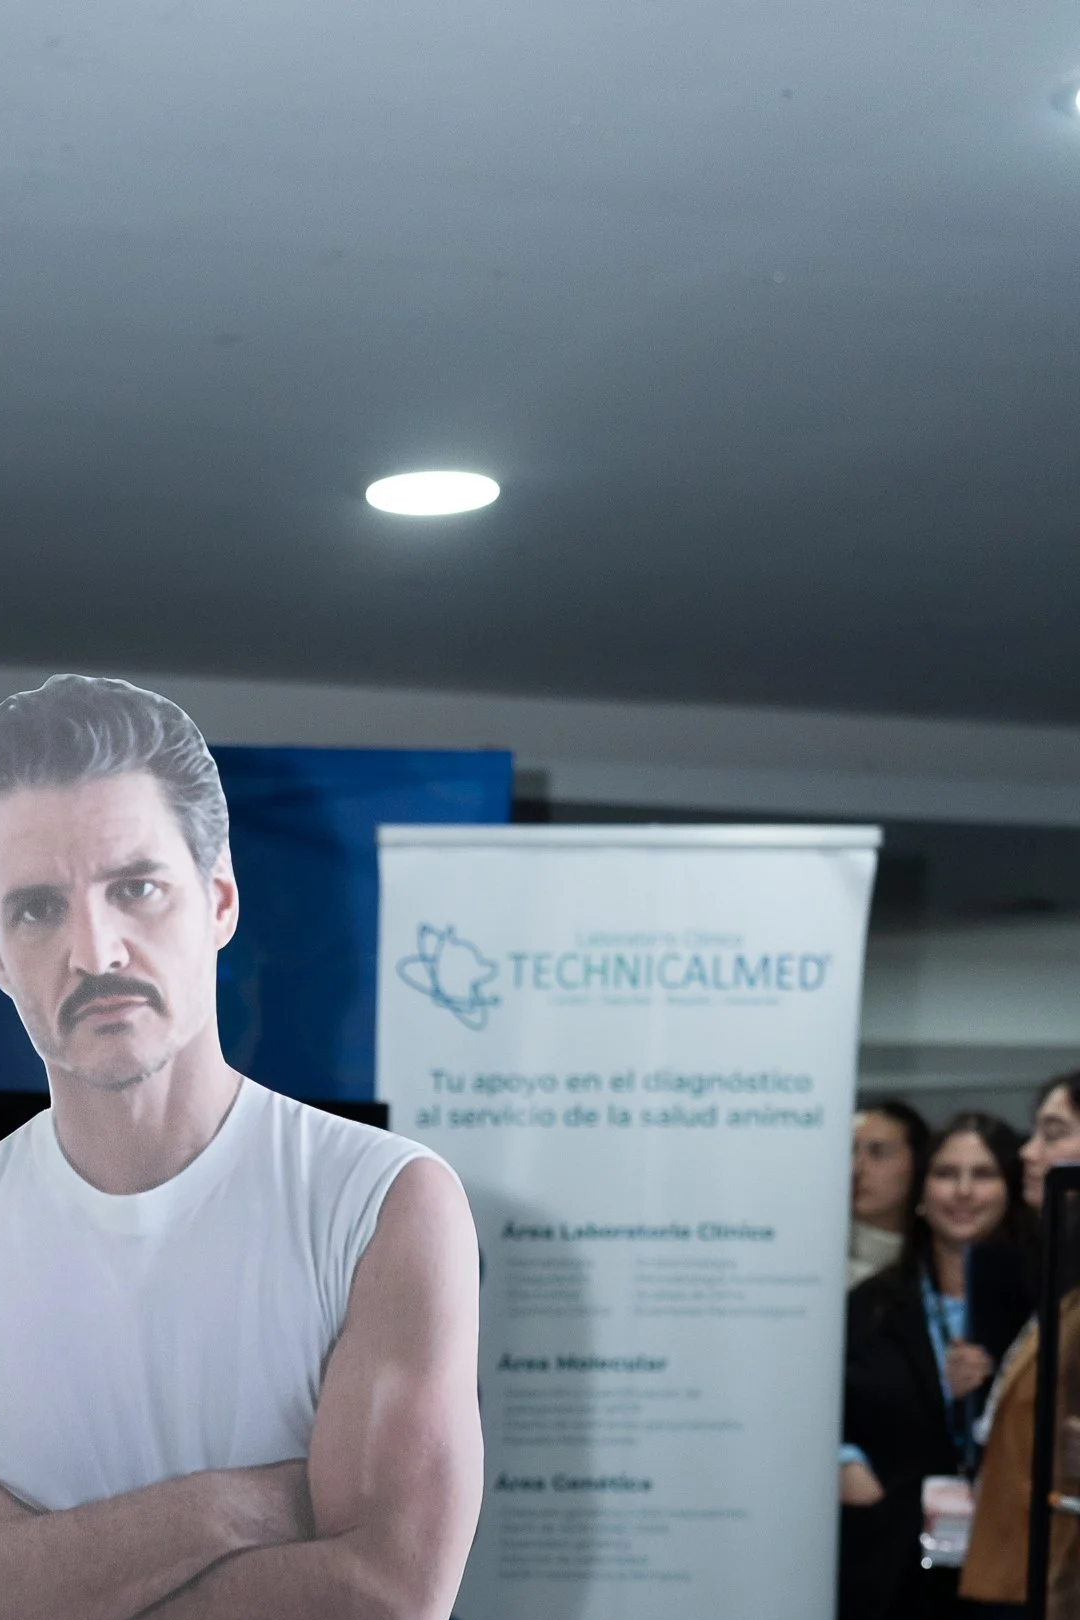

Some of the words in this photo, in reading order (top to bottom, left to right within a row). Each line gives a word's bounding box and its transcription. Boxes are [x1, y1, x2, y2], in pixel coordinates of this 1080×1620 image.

[506, 952, 827, 992] TECHNICALMED
[430, 1070, 466, 1094] Tu
[471, 1073, 558, 1098] apoyo
[564, 1073, 603, 1094] en
[608, 1070, 635, 1094] el
[641, 1069, 814, 1099] diagnóstico
[416, 1104, 441, 1128] al
[446, 1104, 558, 1128] servicio
[562, 1104, 602, 1128] de
[606, 1104, 633, 1127] la
[639, 1104, 718, 1129] salud
[725, 1104, 825, 1129] animal
